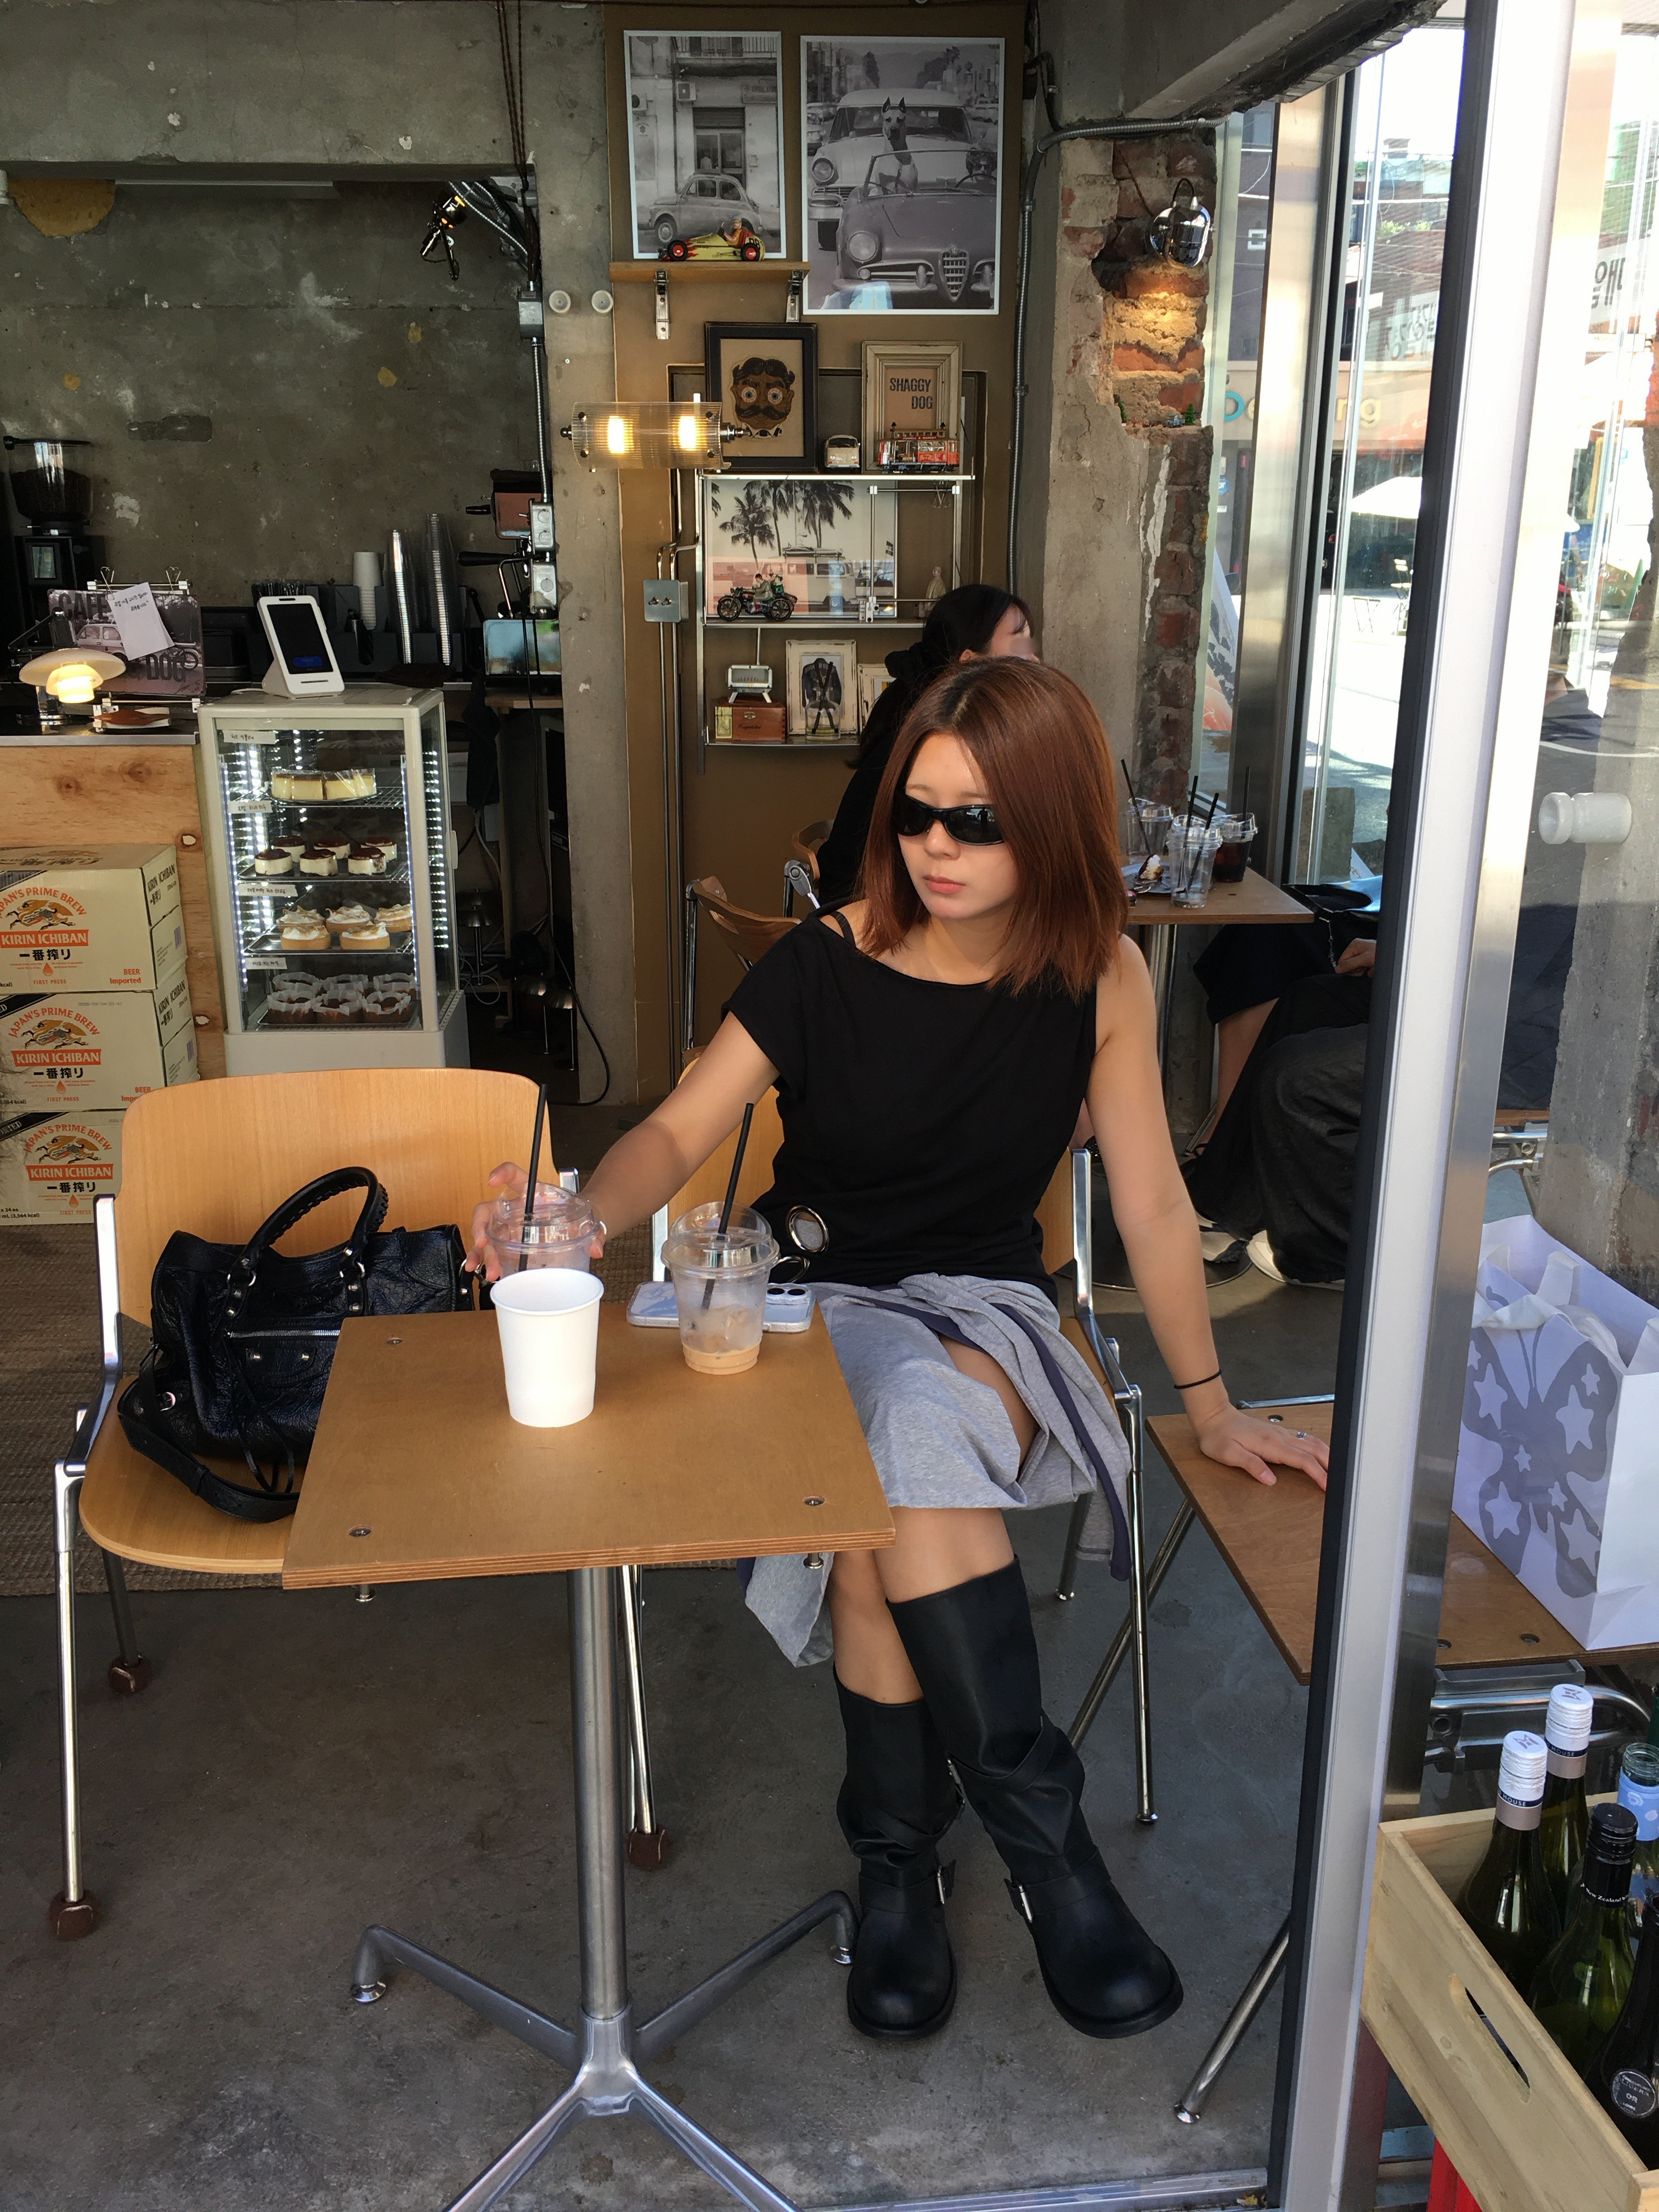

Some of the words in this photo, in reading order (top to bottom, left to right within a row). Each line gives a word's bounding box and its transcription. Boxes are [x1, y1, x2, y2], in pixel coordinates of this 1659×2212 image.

[890, 377, 932, 392] SHAGGY
[911, 396, 933, 409] DOG
[58, 593, 109, 620] CAFE
[26, 887, 59, 898] PRIME
[60, 893, 87, 915] BREW
[1, 934, 36, 945] KIRIN
[38, 933, 87, 944] ICHIBAN
[19, 949, 71, 961] 一番搾り
[110, 977, 142, 985] Imported
[8, 1009, 41, 1039] JAPAN'S
[41, 1007, 74, 1018] PRIME
[74, 1013, 100, 1036] BREW
[16, 1053, 49, 1064] KIRIN
[52, 1052, 99, 1063] ICHIBAN
[33, 1068, 83, 1079] 一番搾り
[23, 1126, 54, 1154] JAPAN'S
[55, 1124, 87, 1134] PRIME
[87, 1128, 113, 1150] BREW
[30, 1167, 63, 1178] KIRIN
[65, 1167, 111, 1177] ICHIBAN
[47, 1182, 96, 1193] 一番搾り
[1551, 1746, 1575, 1757] HOUSE
[1503, 1793, 1526, 1807] HOUSE
[1626, 2093, 1638, 2104] OR
